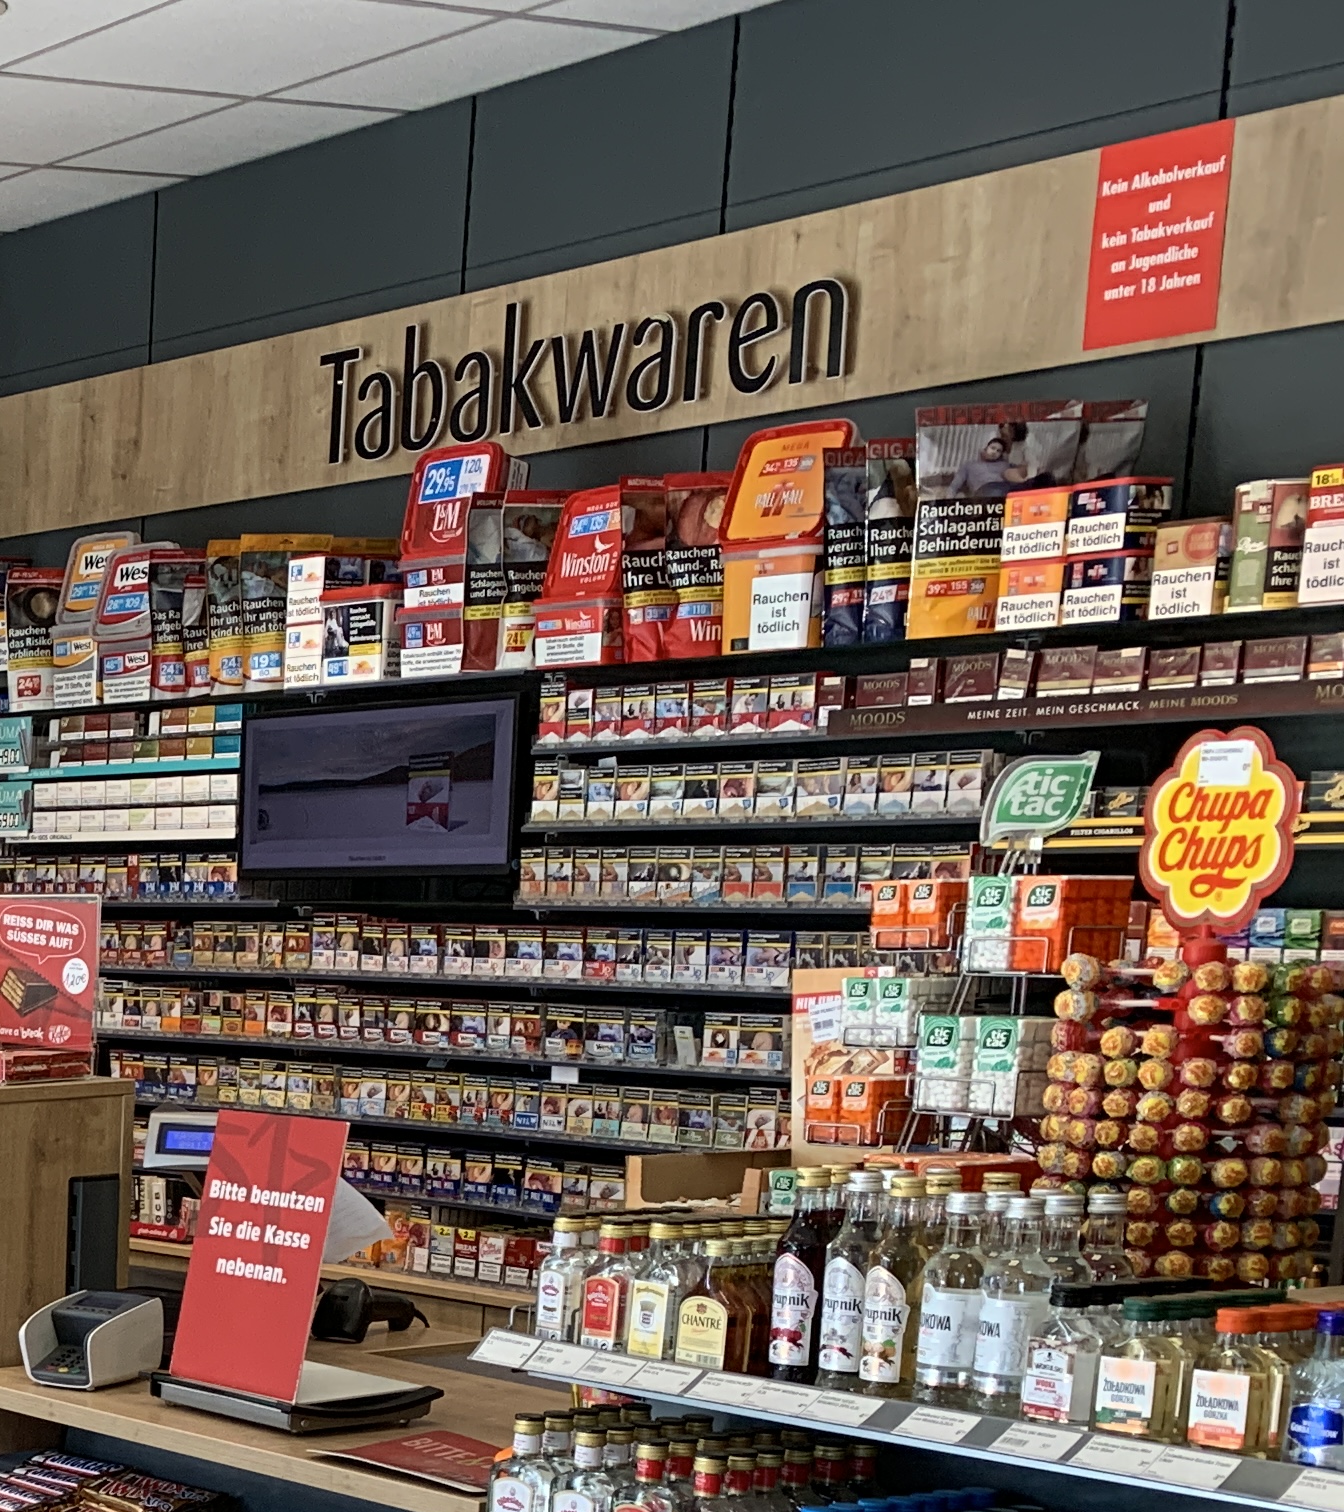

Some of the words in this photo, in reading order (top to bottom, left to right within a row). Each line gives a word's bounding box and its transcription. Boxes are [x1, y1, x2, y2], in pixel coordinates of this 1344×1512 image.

[1102, 178, 1128, 197] Kein
[1131, 155, 1226, 191] Alkoholverkauf
[1148, 193, 1171, 214] und
[1101, 231, 1127, 249] kein
[1131, 211, 1214, 243] Tabakverkauf
[1111, 259, 1126, 273] an
[1128, 243, 1199, 272] Jugendliche
[1104, 283, 1136, 301] unter
[1141, 277, 1156, 293] 18
[1159, 272, 1201, 291] Jahren
[320, 277, 850, 463] Tabakwaren
[781, 441, 809, 453] MEGA
[430, 501, 462, 532] L&M
[920, 503, 984, 518] Rauchen
[1070, 520, 1119, 535] Rauchen
[1006, 528, 1059, 544] Rauchen
[1083, 532, 1121, 547] tödlich
[1022, 539, 1061, 554] tödlich
[666, 549, 716, 562] Rauchen
[562, 551, 612, 580] Winston
[470, 571, 504, 580] Rauchen
[579, 574, 607, 584] VOLUME
[1153, 571, 1212, 585] Rauchen
[753, 590, 809, 605] Rauchen
[1171, 588, 1187, 600] ist
[243, 599, 284, 611] Rauchen
[771, 605, 787, 619] ist
[1154, 601, 1200, 614] tödlich
[244, 610, 258, 622] Ihr
[9, 626, 47, 637] Rauchen
[244, 622, 265, 634] Kind
[564, 619, 595, 631] Winston
[757, 619, 800, 634] tödlich
[9, 639, 25, 649] das
[26, 637, 53, 648] Risiko
[72, 639, 92, 651] West
[9, 648, 52, 659] erblinden
[126, 653, 147, 665] West
[863, 679, 901, 693] MOODS
[967, 707, 1003, 720] MEINE
[1035, 704, 1065, 717] MEIN
[1149, 698, 1187, 710] MEINE
[1190, 694, 1239, 706] MOODS
[849, 710, 906, 727] MOODS
[1026, 768, 1070, 796] tic
[1010, 795, 1061, 817] tac
[1168, 782, 1273, 832] Chupa
[1158, 826, 1267, 882] Chups
[984, 887, 1002, 897] tic
[1035, 886, 1052, 896] tic
[980, 895, 1001, 905] tac
[1030, 894, 1052, 904] tac
[3, 913, 34, 929] REISS
[36, 919, 54, 931] DIR
[56, 921, 79, 935] WAS
[7, 927, 47, 945] SÜSSES
[49, 936, 73, 950] AUF!
[14, 1028, 20, 1037] a
[20, 1027, 44, 1041] break
[209, 1179, 246, 1202] Bitte
[250, 1185, 325, 1213] benutzen
[208, 1216, 234, 1238] Sie
[235, 1220, 260, 1241] die
[263, 1225, 311, 1250] Kasse
[216, 1256, 287, 1285] nebenan.
[681, 1312, 722, 1330] CHANTRÉ
